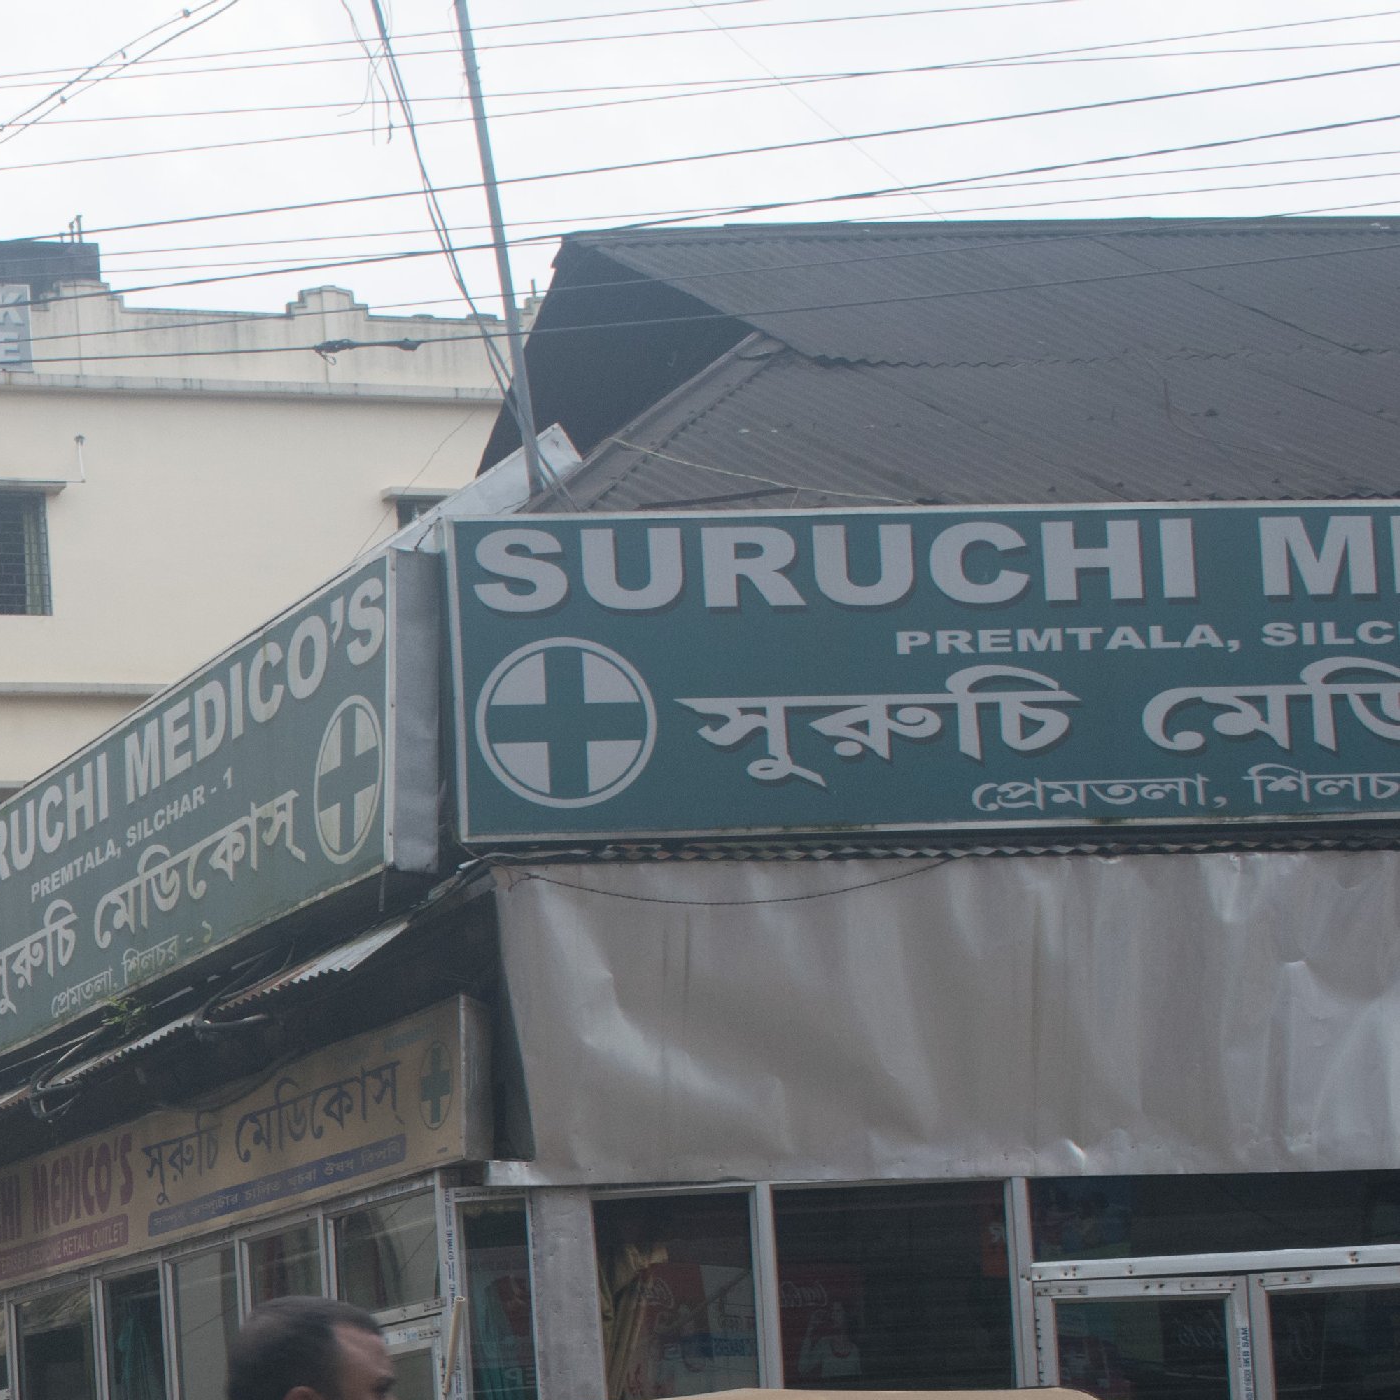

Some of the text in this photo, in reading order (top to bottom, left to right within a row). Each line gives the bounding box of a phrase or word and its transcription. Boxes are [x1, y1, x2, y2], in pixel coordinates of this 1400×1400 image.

[473, 515, 1199, 613] SURUCHI
[124, 576, 385, 806] MEDICO'S
[896, 621, 1240, 655] PREMTALA,
[676, 664, 1082, 788] সুরুচি
[30, 839, 122, 903] PREMTALA,
[125, 785, 206, 846] SILCHAR
[62, 1232, 92, 1259] RETAIL
[92, 1221, 125, 1248] OUTLET
